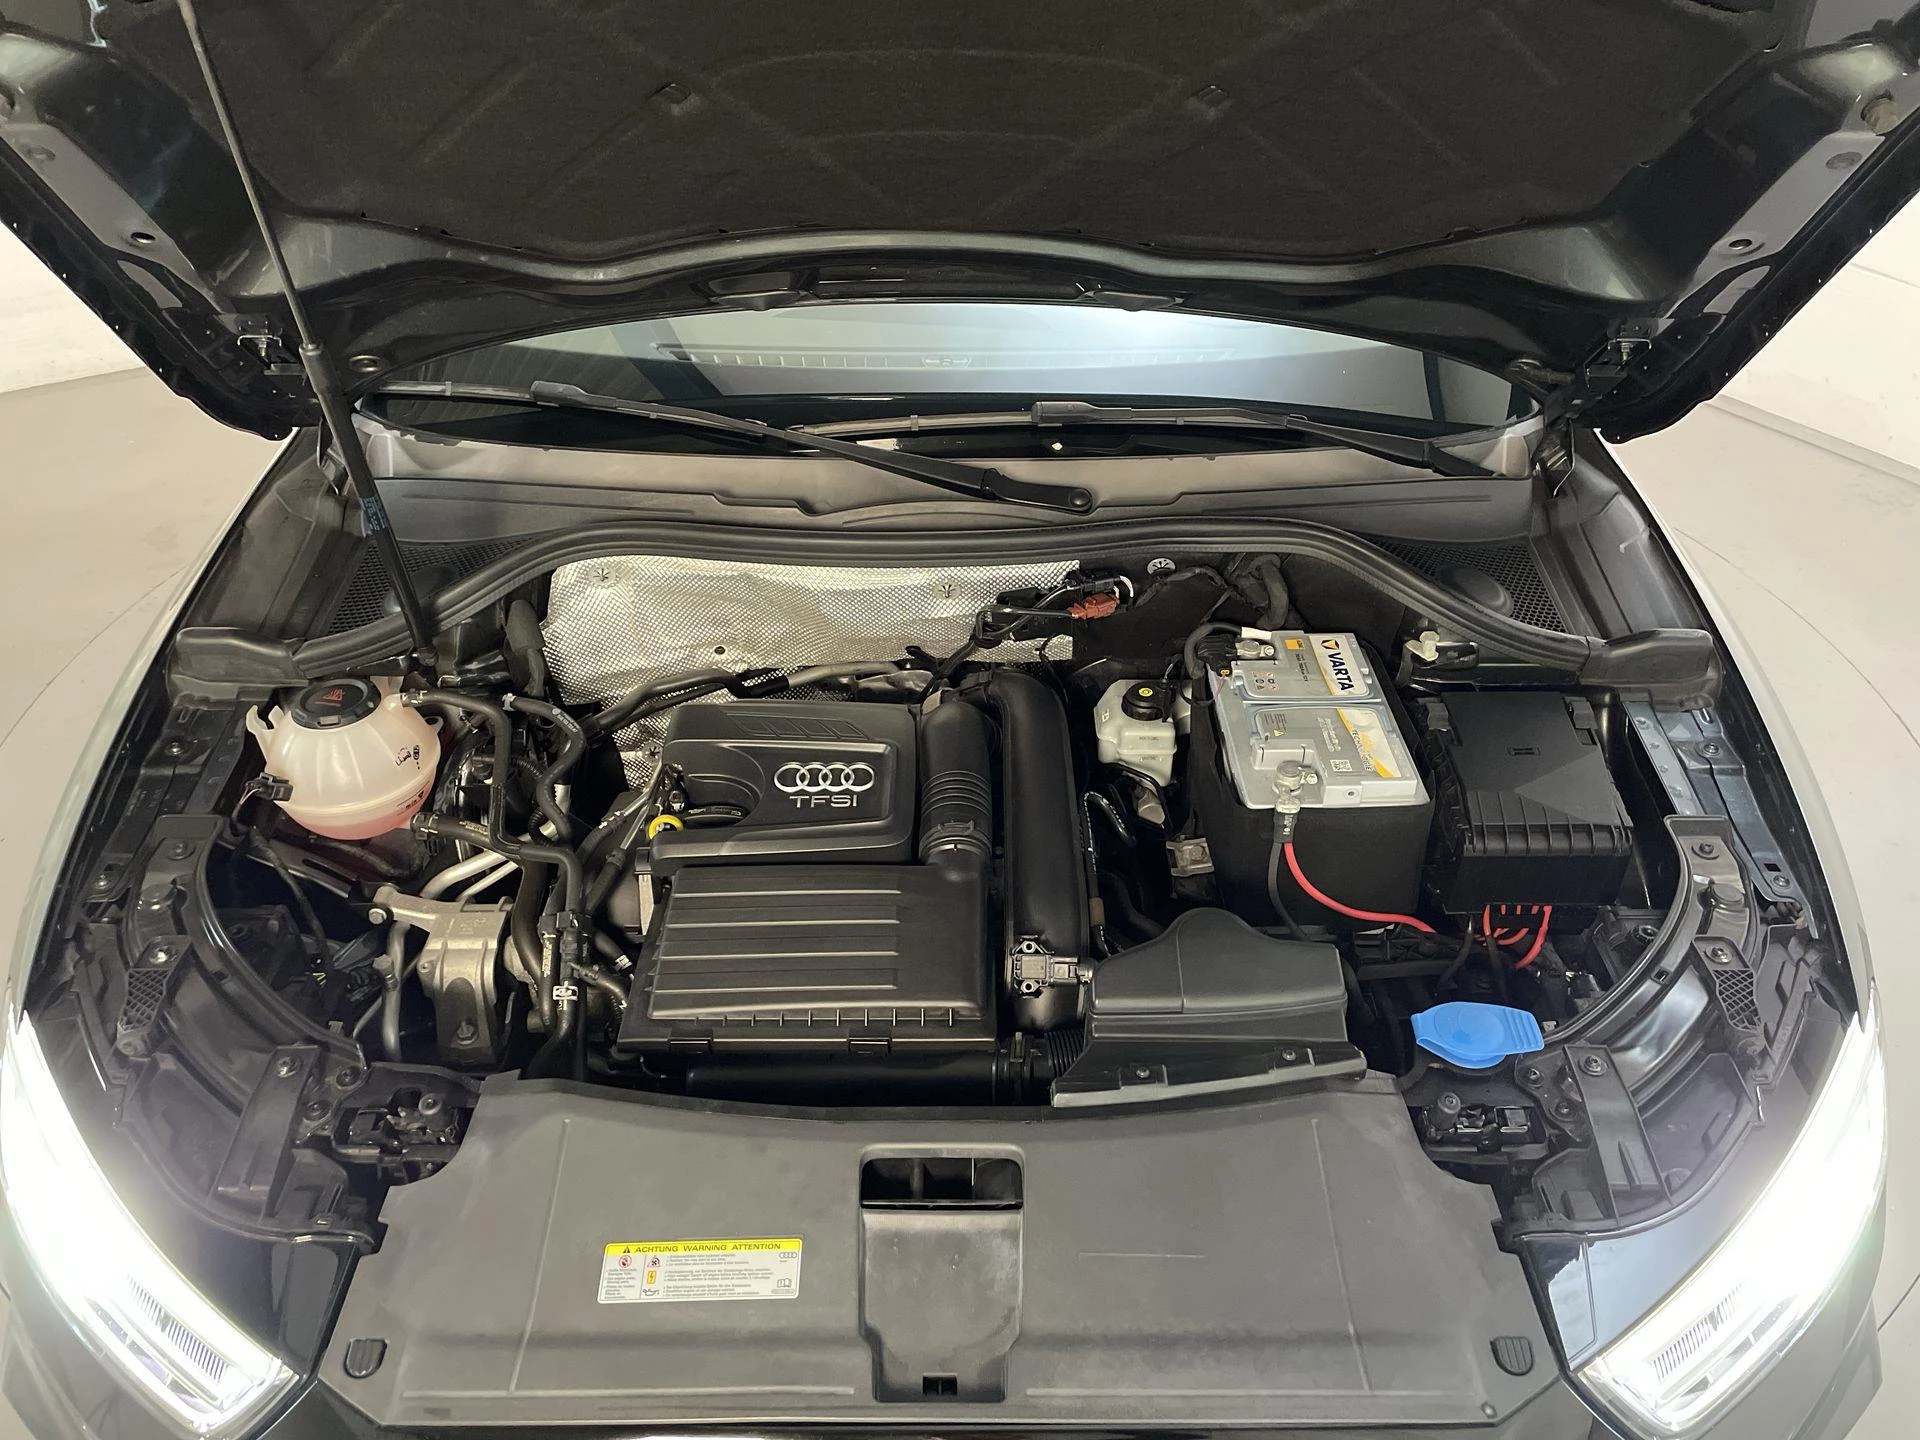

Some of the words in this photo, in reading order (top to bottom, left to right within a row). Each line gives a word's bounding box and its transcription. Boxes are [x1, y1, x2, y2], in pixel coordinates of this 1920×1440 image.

[1328, 652, 1354, 690] VARTA
[1352, 729, 1373, 771] TECHNOGIE
[789, 794, 857, 808] TFSI
[634, 1245, 679, 1253] ACHTUNG
[683, 1244, 727, 1252] WARNING
[731, 1243, 781, 1251] ATTENTION
